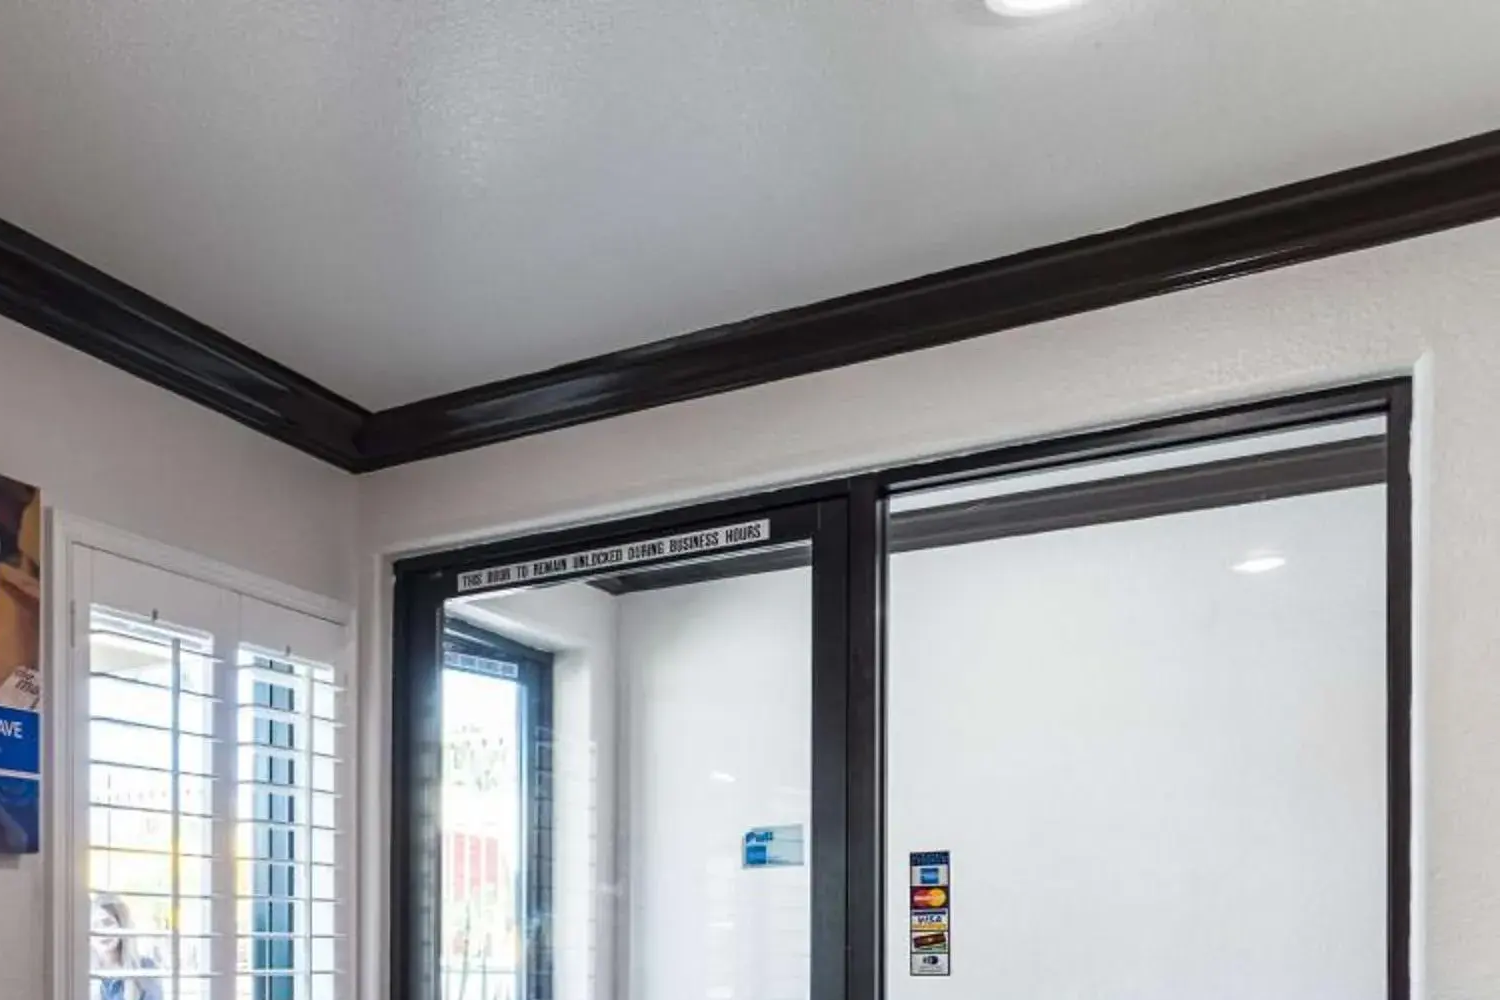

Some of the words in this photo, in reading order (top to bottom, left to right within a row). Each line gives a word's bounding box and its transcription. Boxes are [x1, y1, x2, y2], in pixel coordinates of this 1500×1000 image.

[462, 573, 483, 587] THIS
[487, 569, 511, 583] DOOR
[517, 566, 529, 579] TO
[533, 560, 567, 576] REMAIN
[573, 549, 623, 570] UNLOCKED
[628, 540, 664, 560] DURING
[669, 532, 719, 553] BUSINESS
[725, 523, 761, 543] HOURS
[917, 914, 942, 924] VISA
